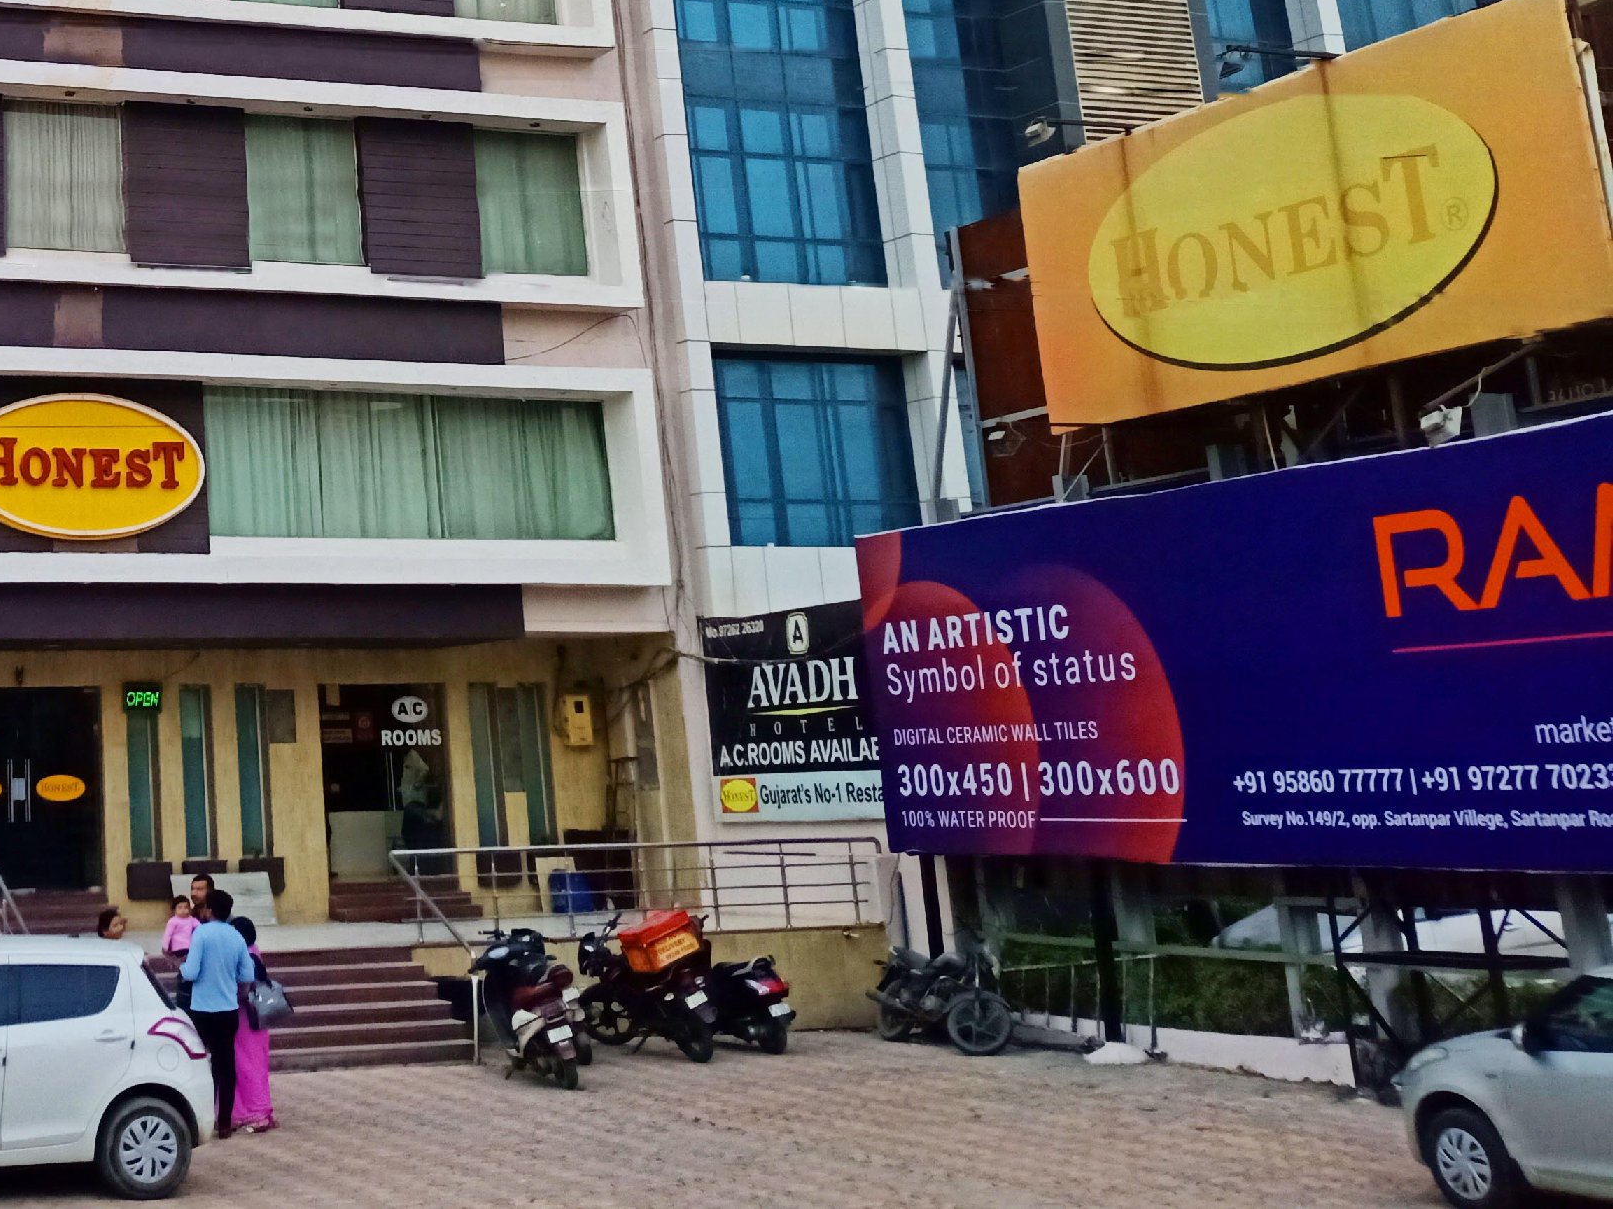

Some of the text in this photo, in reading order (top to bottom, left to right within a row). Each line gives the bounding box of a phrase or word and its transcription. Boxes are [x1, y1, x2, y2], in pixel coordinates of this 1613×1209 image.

[1111, 144, 1440, 318] HONEST
[883, 604, 1070, 654] AN ARTISTIC
[747, 656, 859, 708] AVADH
[887, 649, 1136, 704] Symbol of status
[126, 691, 159, 707] OPEN
[381, 729, 442, 746] ROOMS
[893, 720, 1098, 746] DIGITAL CERAMIC WALL TILES
[898, 762, 1013, 797] 300x450
[1039, 758, 1180, 796] 300x600
[1233, 770, 1267, 793] +91
[1272, 769, 1335, 793] 95860
[1338, 768, 1403, 793] 77777
[1421, 766, 1461, 791] +91
[1467, 764, 1539, 790] 97277
[759, 783, 812, 809] Gujarat's
[901, 810, 1036, 829] 100% WATER PROOF
[1242, 810, 1283, 829] Survey
[1351, 813, 1381, 830] opp.
[1384, 810, 1450, 829] Sartanpar
[1453, 809, 1508, 830] Villege,
[1510, 809, 1586, 831] Sartanpar
